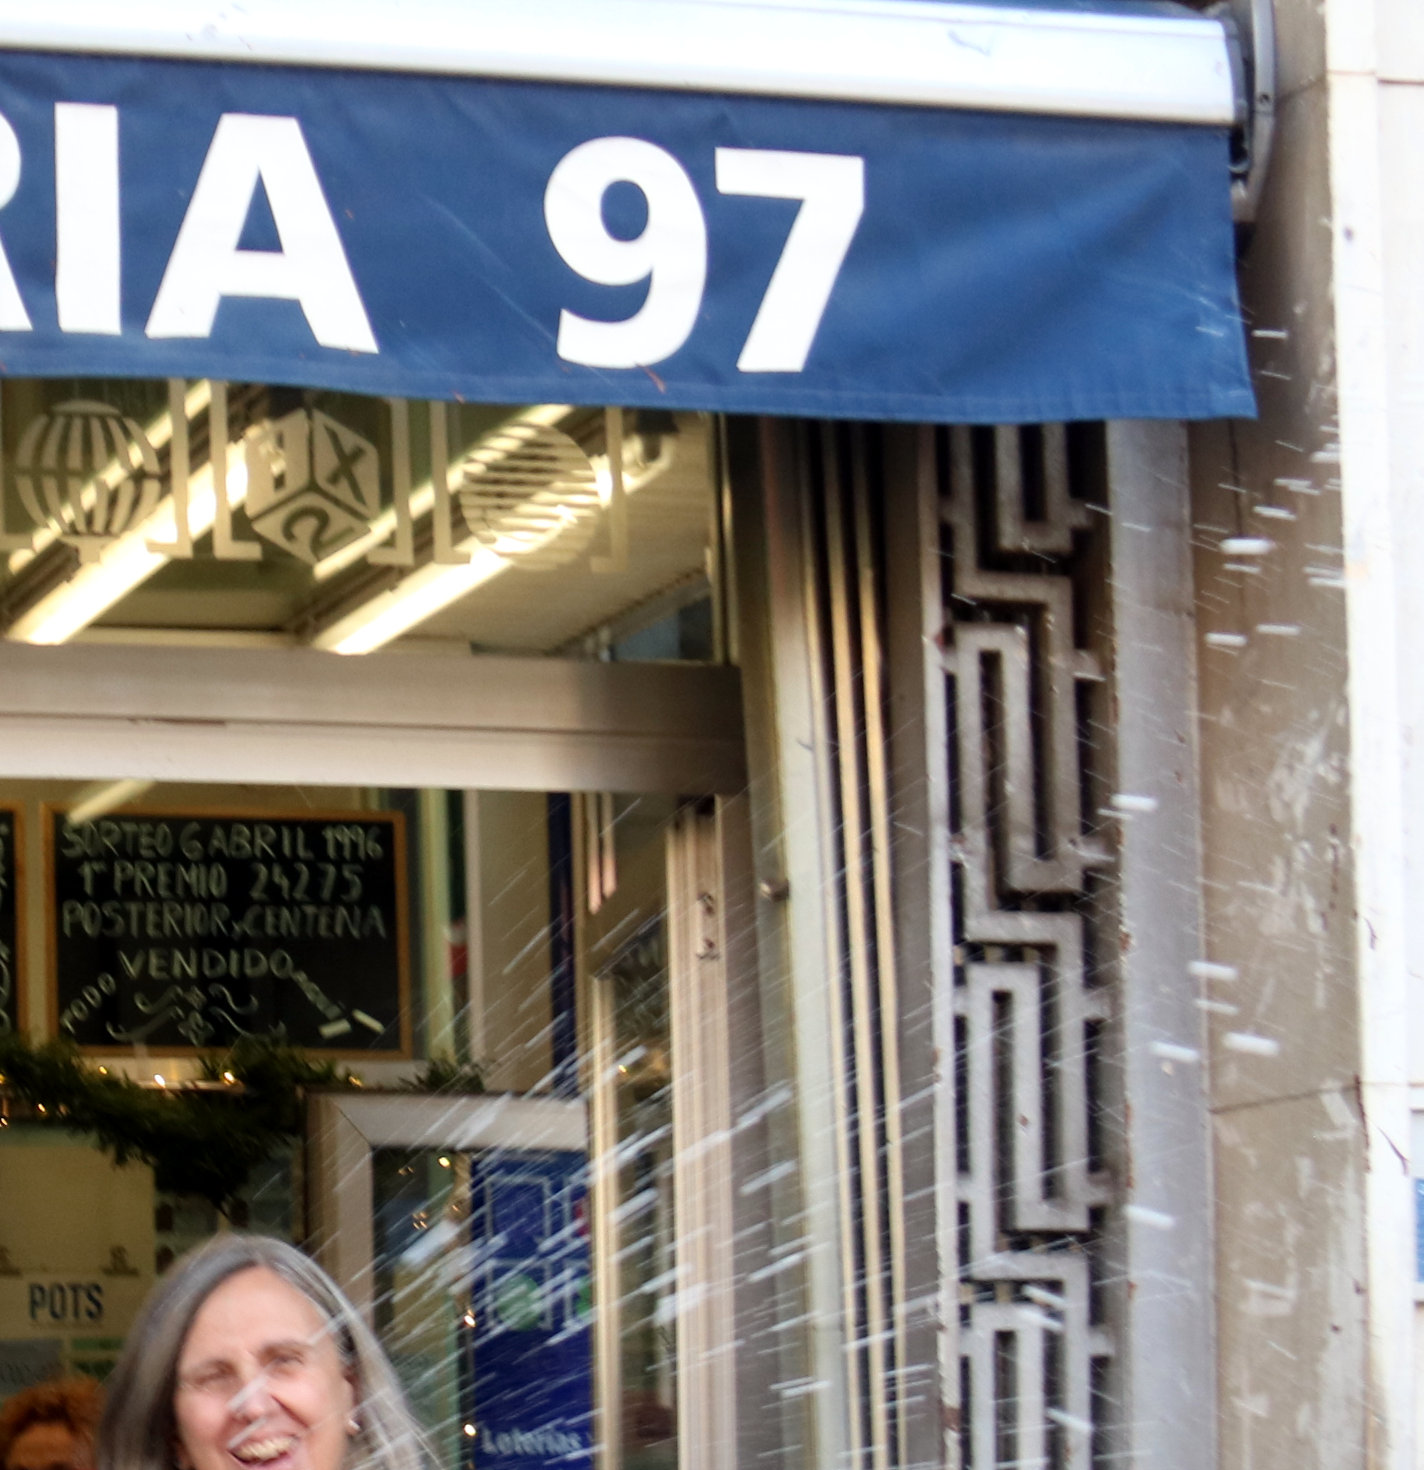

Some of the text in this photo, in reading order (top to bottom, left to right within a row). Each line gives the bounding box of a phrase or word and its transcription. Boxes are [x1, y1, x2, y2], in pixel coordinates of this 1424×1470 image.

[545, 135, 865, 373] 97
[208, 822, 315, 861] ABRIL
[113, 861, 229, 900] PREMIO
[249, 861, 365, 902] 24275
[117, 949, 294, 980] VENDIDO
[29, 1282, 104, 1323] POTS
